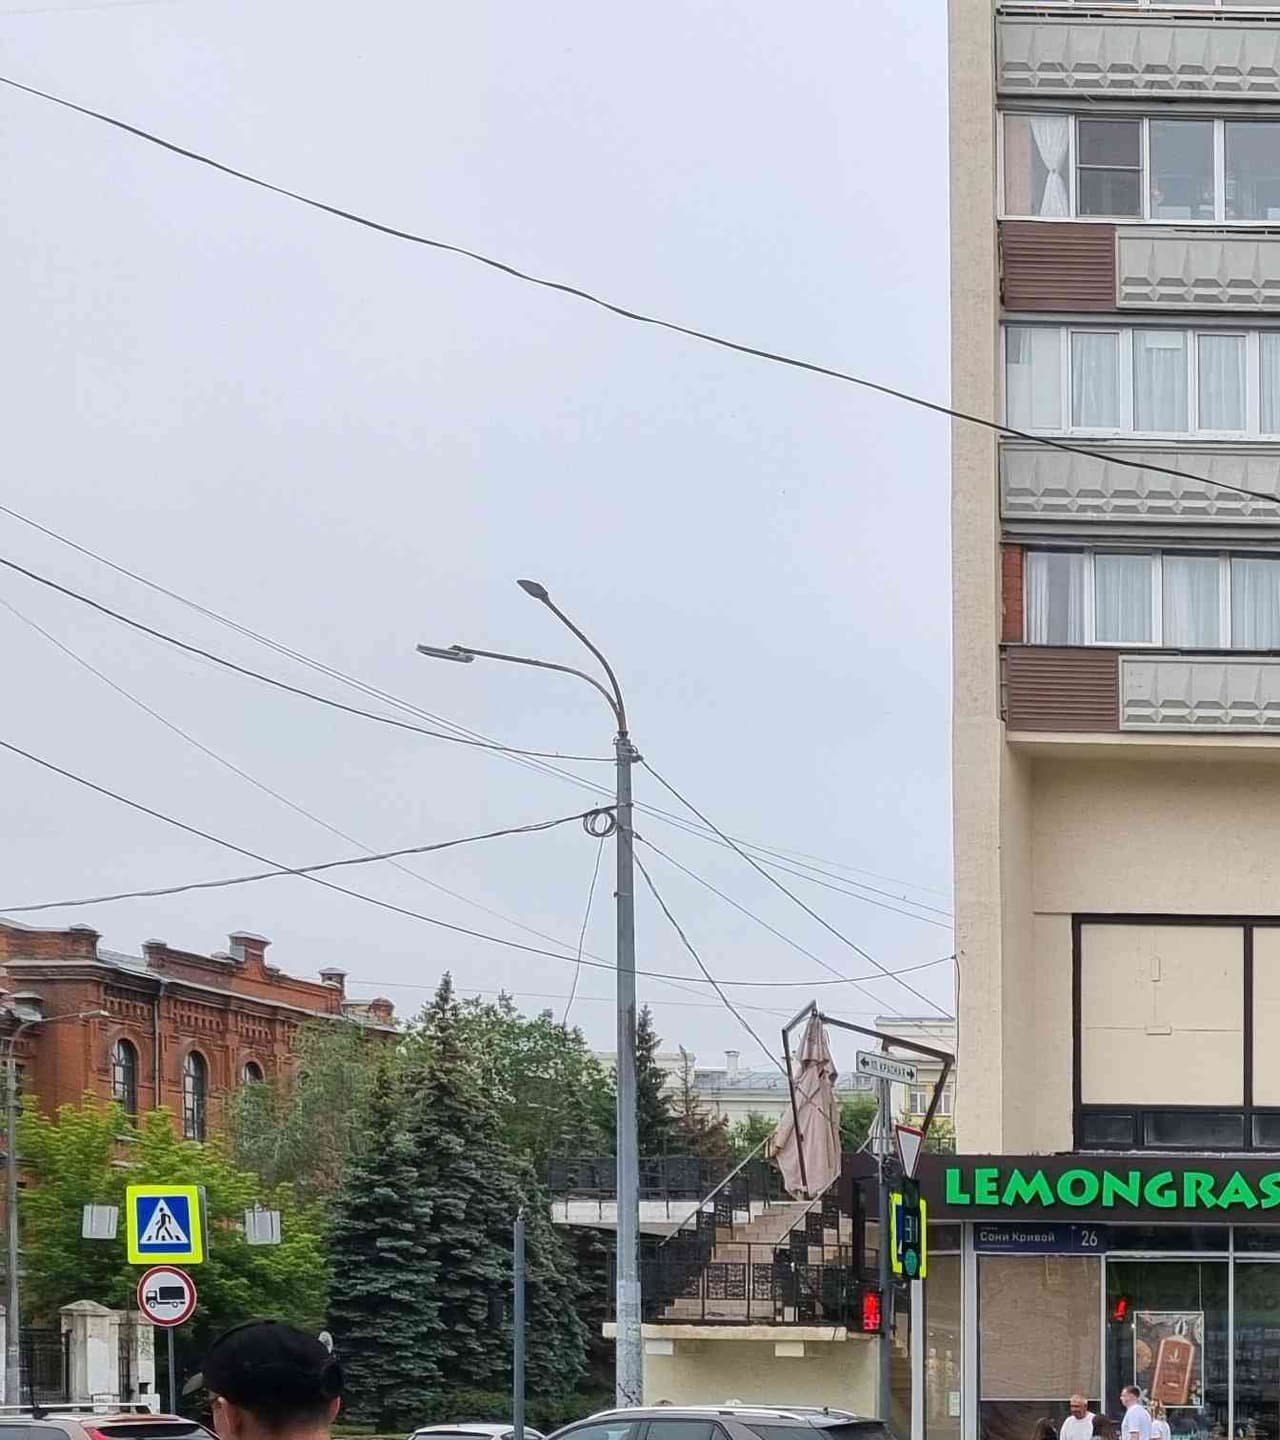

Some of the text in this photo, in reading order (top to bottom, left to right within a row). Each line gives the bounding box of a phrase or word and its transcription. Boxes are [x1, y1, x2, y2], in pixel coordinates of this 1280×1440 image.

[979, 1231, 1055, 1243] Сони Кривой
[1081, 1230, 1098, 1247] 26
